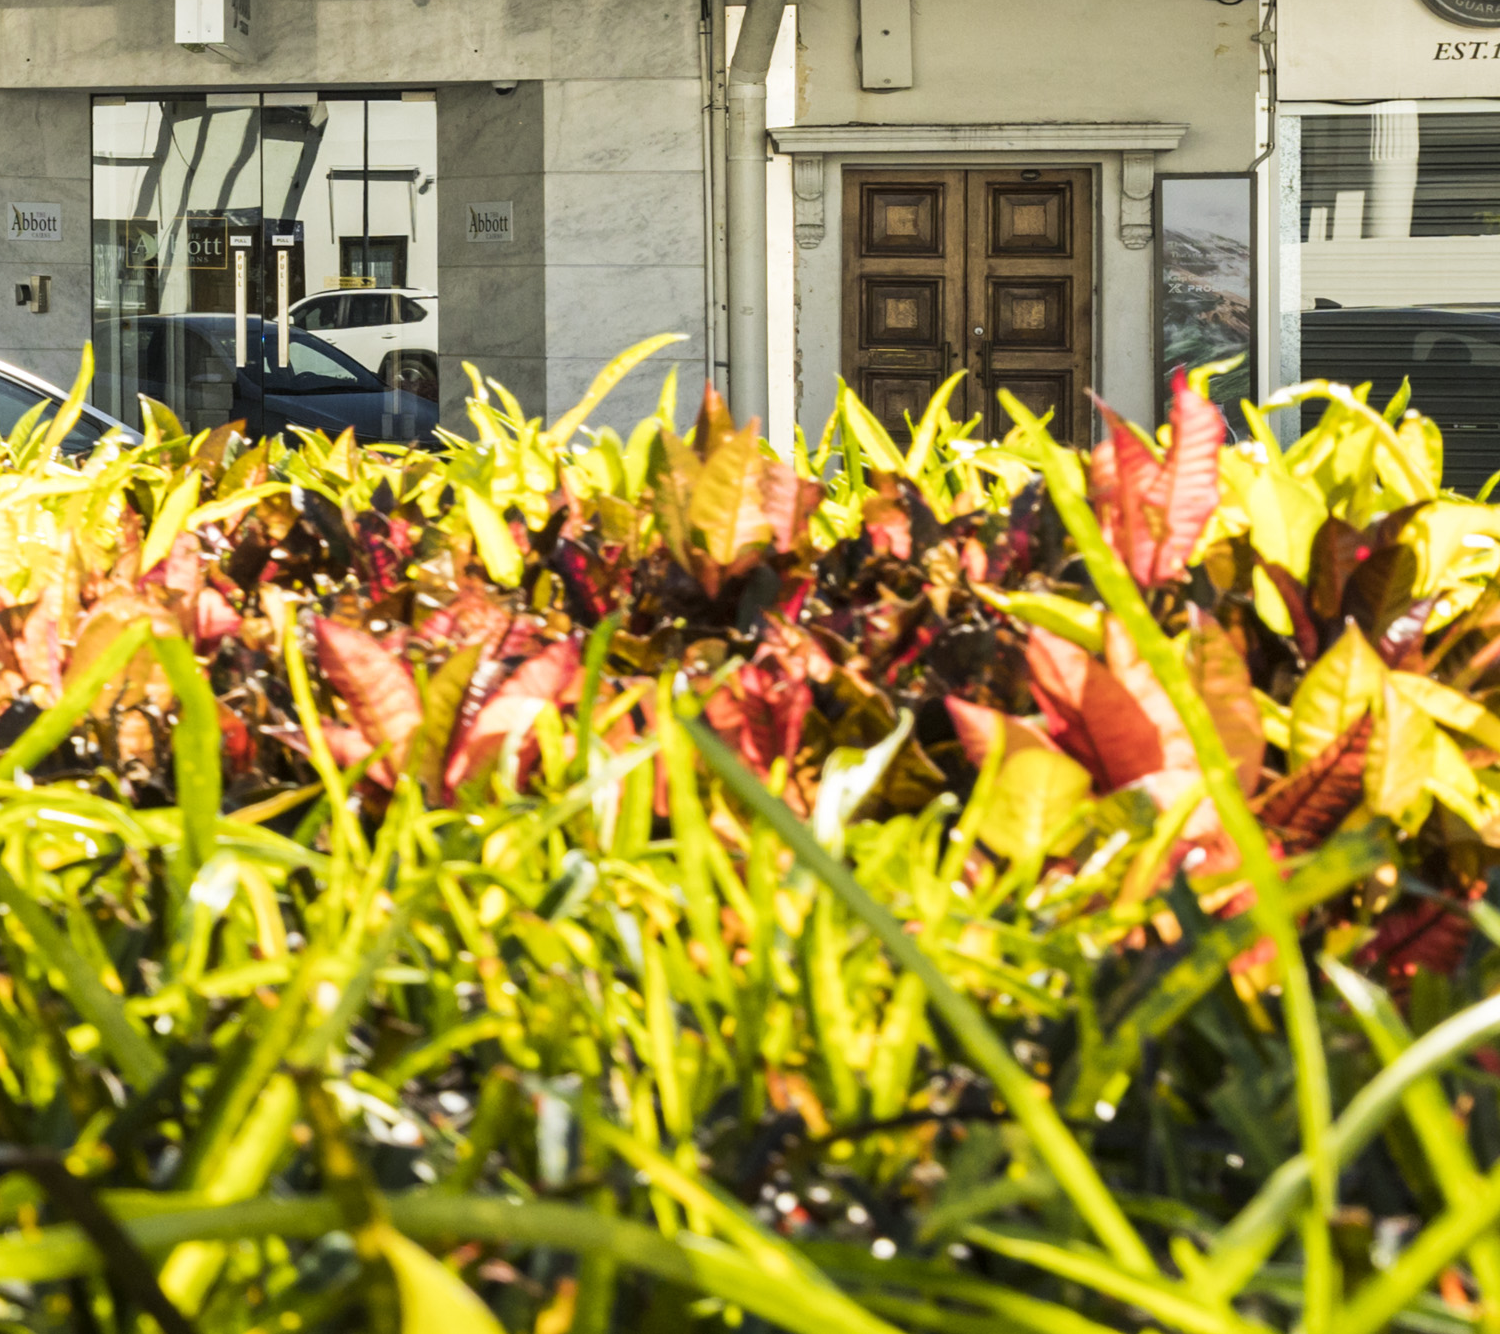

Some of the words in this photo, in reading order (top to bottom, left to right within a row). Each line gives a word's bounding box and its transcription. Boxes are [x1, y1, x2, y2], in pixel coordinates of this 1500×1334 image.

[11, 211, 57, 232] Abbott
[469, 212, 508, 233] Abbott
[132, 233, 222, 256] Aott
